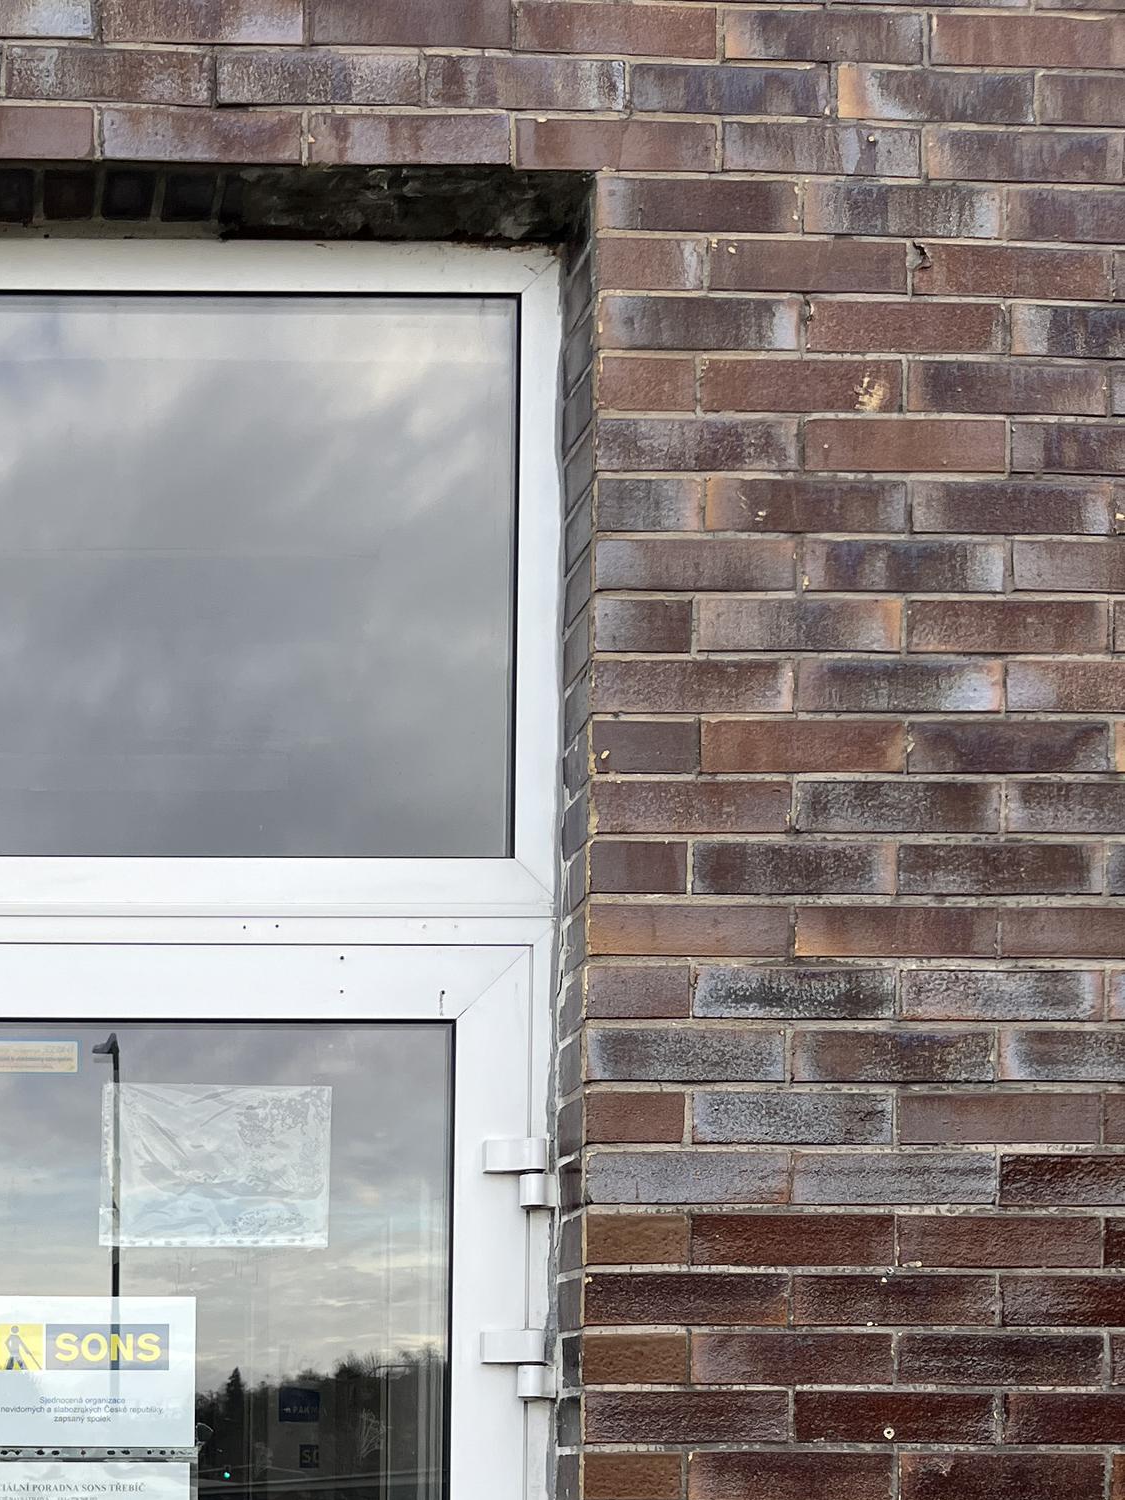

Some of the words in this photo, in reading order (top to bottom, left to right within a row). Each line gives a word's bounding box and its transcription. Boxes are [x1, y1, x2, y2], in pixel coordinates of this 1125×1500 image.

[54, 1332, 161, 1363] SONS
[38, 1396, 84, 1406] Sjednocená
[85, 1397, 126, 1406] organizace
[0, 1405, 45, 1415] nevidomých
[53, 1405, 102, 1415] slabozrakých
[104, 1404, 127, 1414] České
[53, 1414, 85, 1424] zapsaný
[86, 1414, 112, 1424] spolek
[32, 1483, 79, 1493] PORADNA
[81, 1483, 107, 1493] SONS
[108, 1482, 146, 1493] TŘEBÍČ
